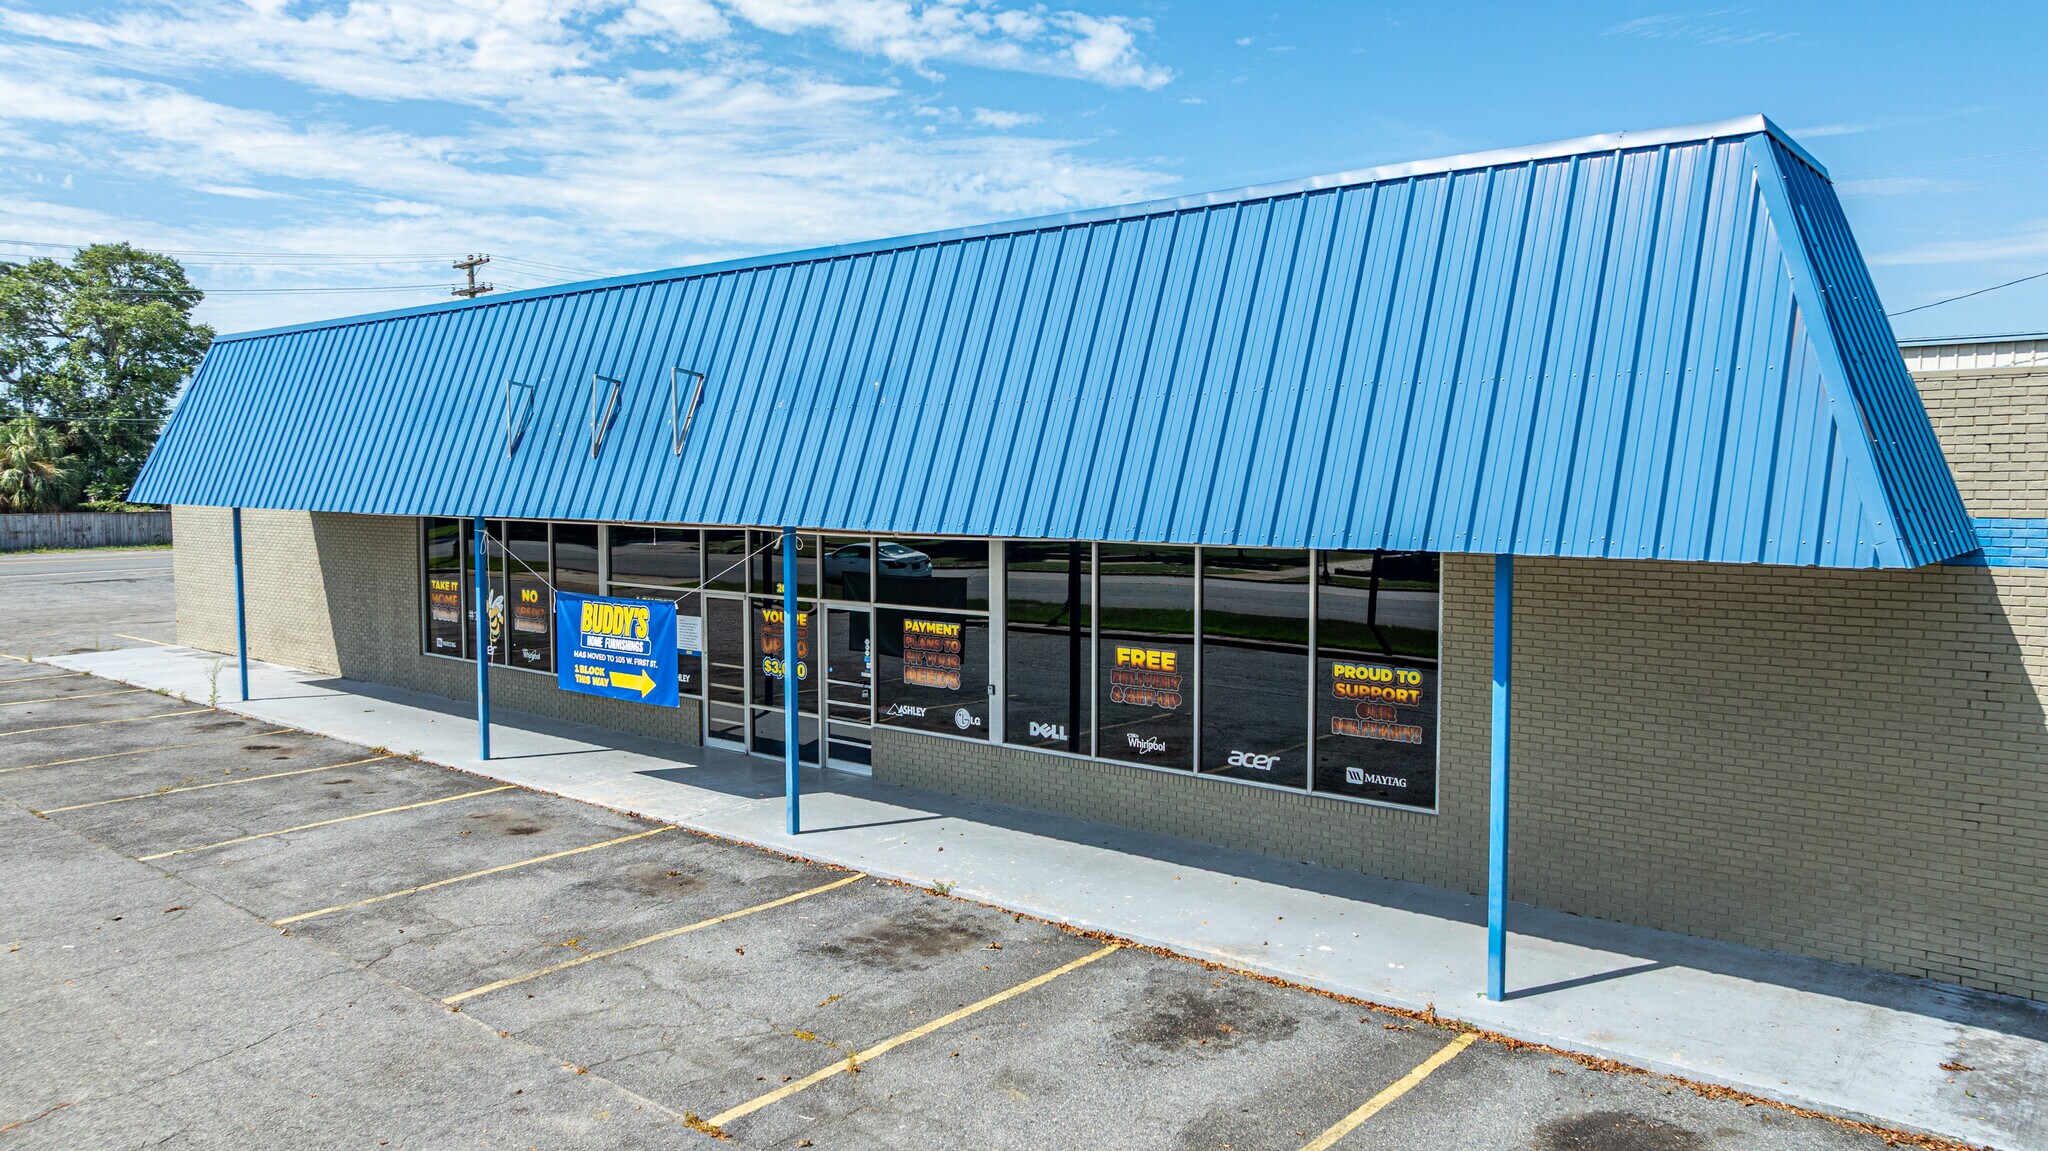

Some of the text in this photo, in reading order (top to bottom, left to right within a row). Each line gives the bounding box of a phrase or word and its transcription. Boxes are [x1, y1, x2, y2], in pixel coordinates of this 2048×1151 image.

[431, 580, 459, 592] TAKE IT
[431, 592, 458, 607] HOME
[521, 589, 538, 603] NO
[581, 602, 649, 639] BUDDY'S
[904, 619, 960, 637] PAYMENT
[586, 636, 644, 653] HOME FURNISHINGS
[762, 636, 783, 654] UP
[904, 635, 960, 653] PLANS TO
[573, 650, 658, 669] HAS MOVED TO 105 W. FIRST ST.
[1116, 647, 1176, 673] FREE
[574, 664, 606, 676] 1 BLOCK
[904, 666, 960, 690] NEEDS
[1333, 663, 1421, 685] PROUD TO
[574, 674, 609, 687] THIS WAY
[1333, 682, 1421, 705] SUPPORT
[898, 704, 927, 717] ASHLEY
[1356, 703, 1397, 722] OUR
[970, 716, 981, 726] LG
[1029, 721, 1068, 741] DELL
[1127, 735, 1166, 754] Whirlpool
[1227, 750, 1280, 771] acer
[1365, 773, 1407, 788] MAYTAG
